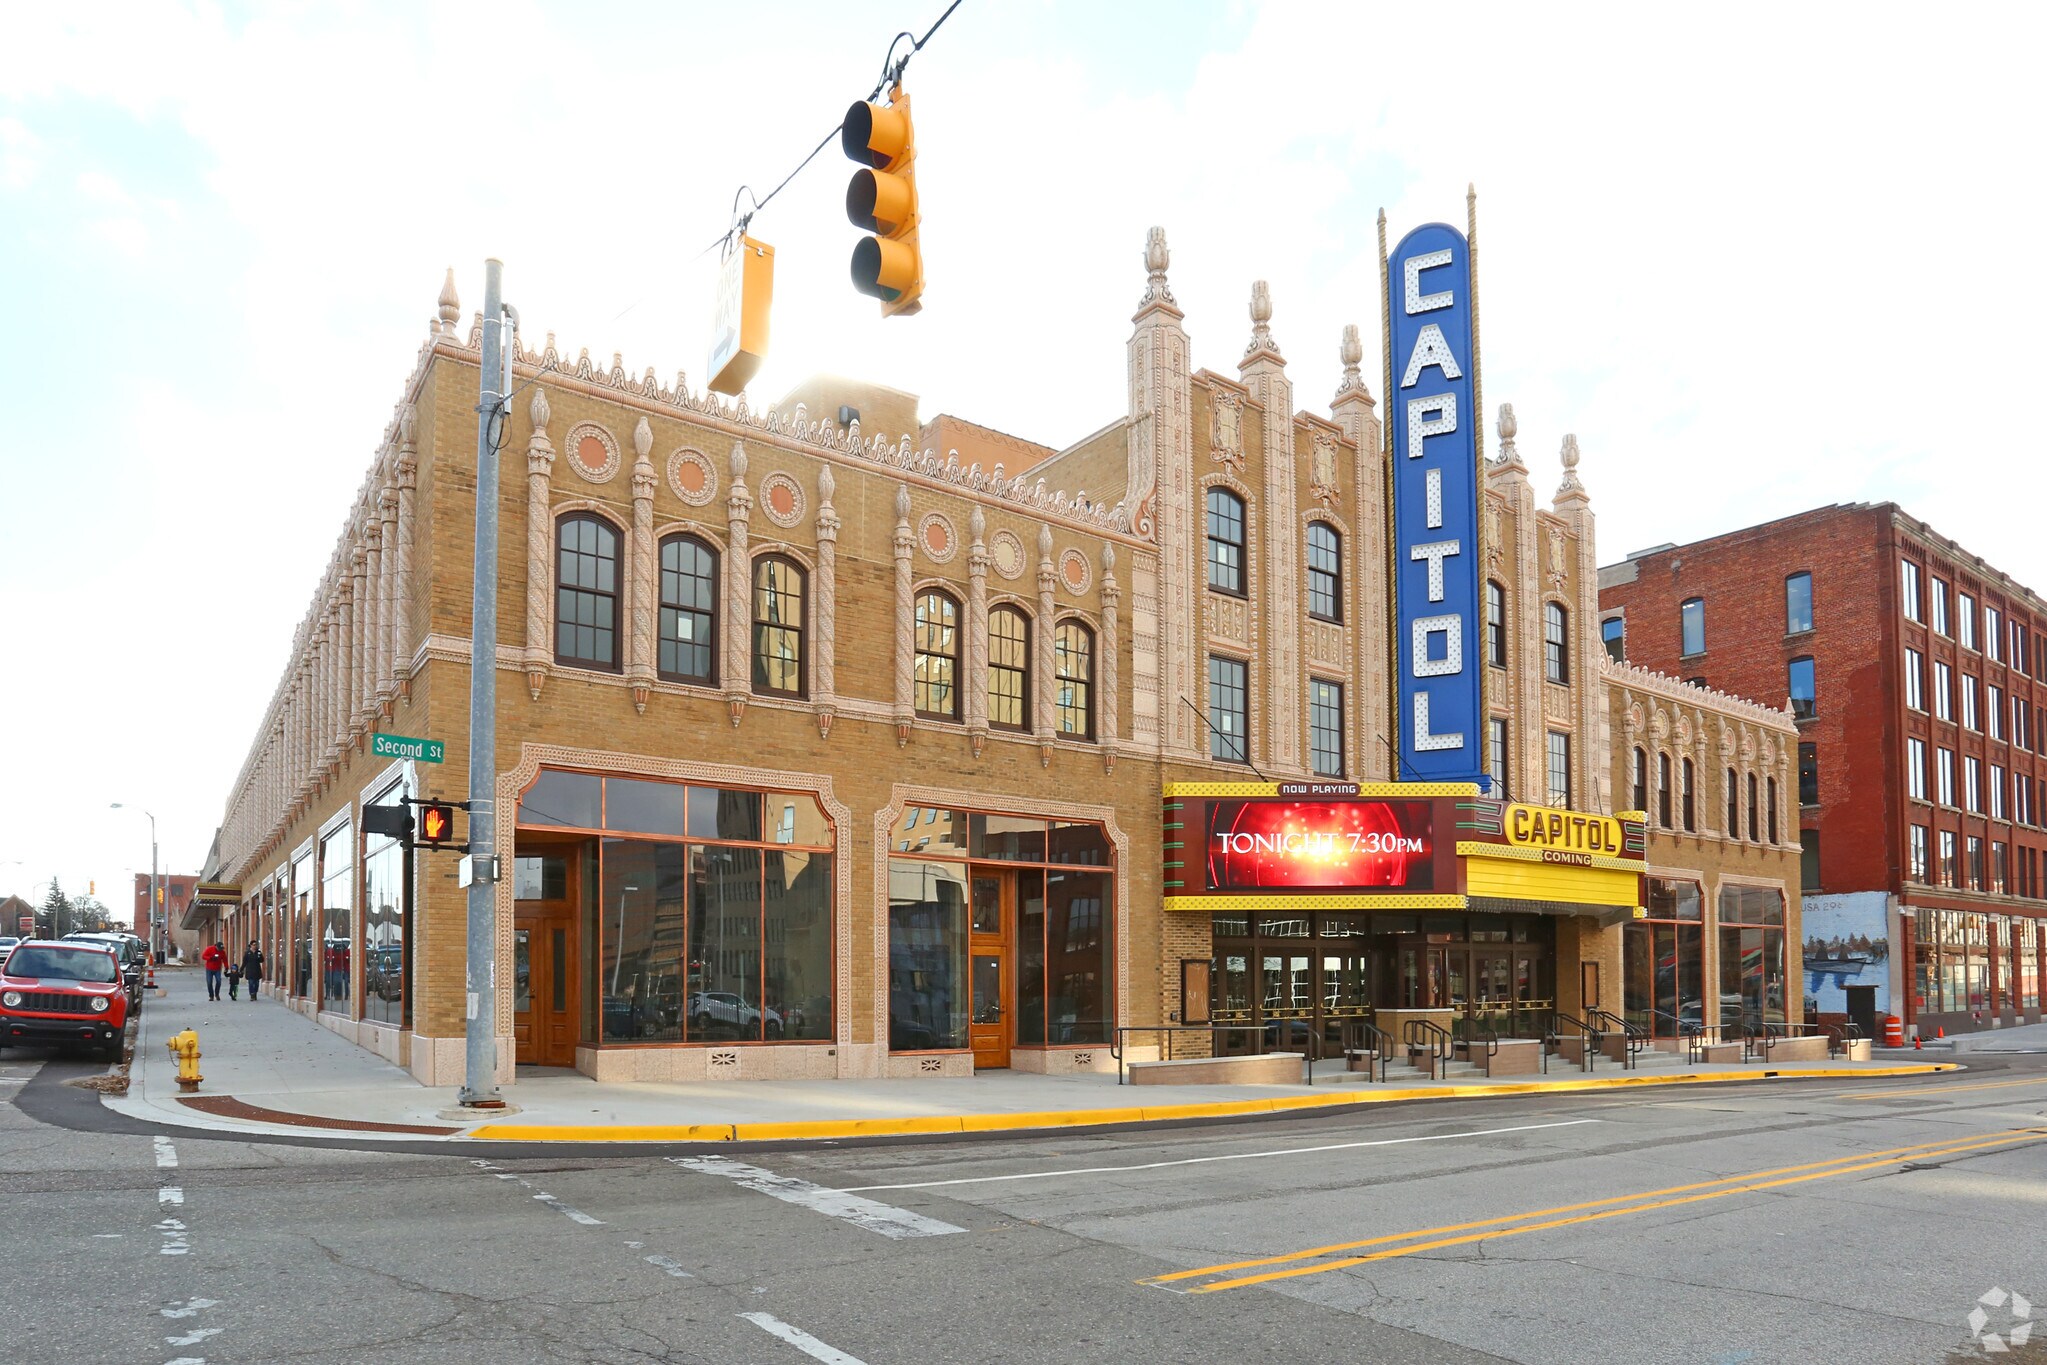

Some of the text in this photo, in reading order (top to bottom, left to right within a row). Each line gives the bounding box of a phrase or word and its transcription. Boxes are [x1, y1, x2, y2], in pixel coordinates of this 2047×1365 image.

[716, 259, 738, 303] ONE
[716, 287, 738, 333] WAY
[1401, 248, 1464, 752] CAPITOL
[376, 737, 442, 758] Second St
[1283, 785, 1356, 794] NOW PLAYING
[1514, 809, 1616, 852] CAPITOL
[1216, 832, 1423, 854] TONIGHT 7:30PM
[1545, 852, 1591, 865] COMING
[1801, 902, 1820, 912] USA
